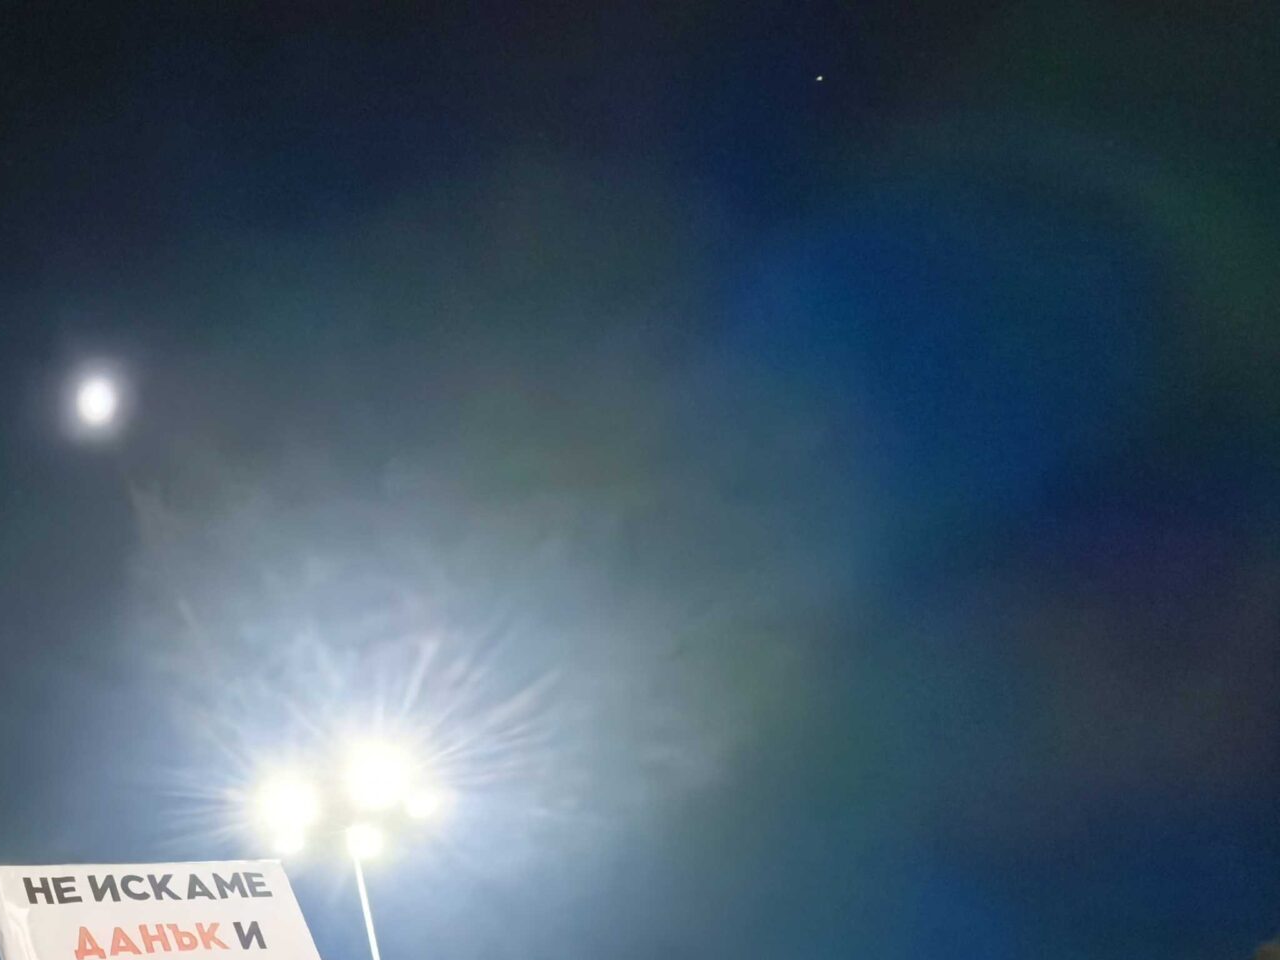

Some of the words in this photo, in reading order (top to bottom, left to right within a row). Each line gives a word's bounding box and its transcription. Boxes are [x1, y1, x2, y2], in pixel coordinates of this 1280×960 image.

[22, 876, 83, 905] НЕ
[87, 872, 273, 904] ИСКАМЕ
[74, 922, 229, 960] ДАНЪК
[233, 920, 268, 950] И
